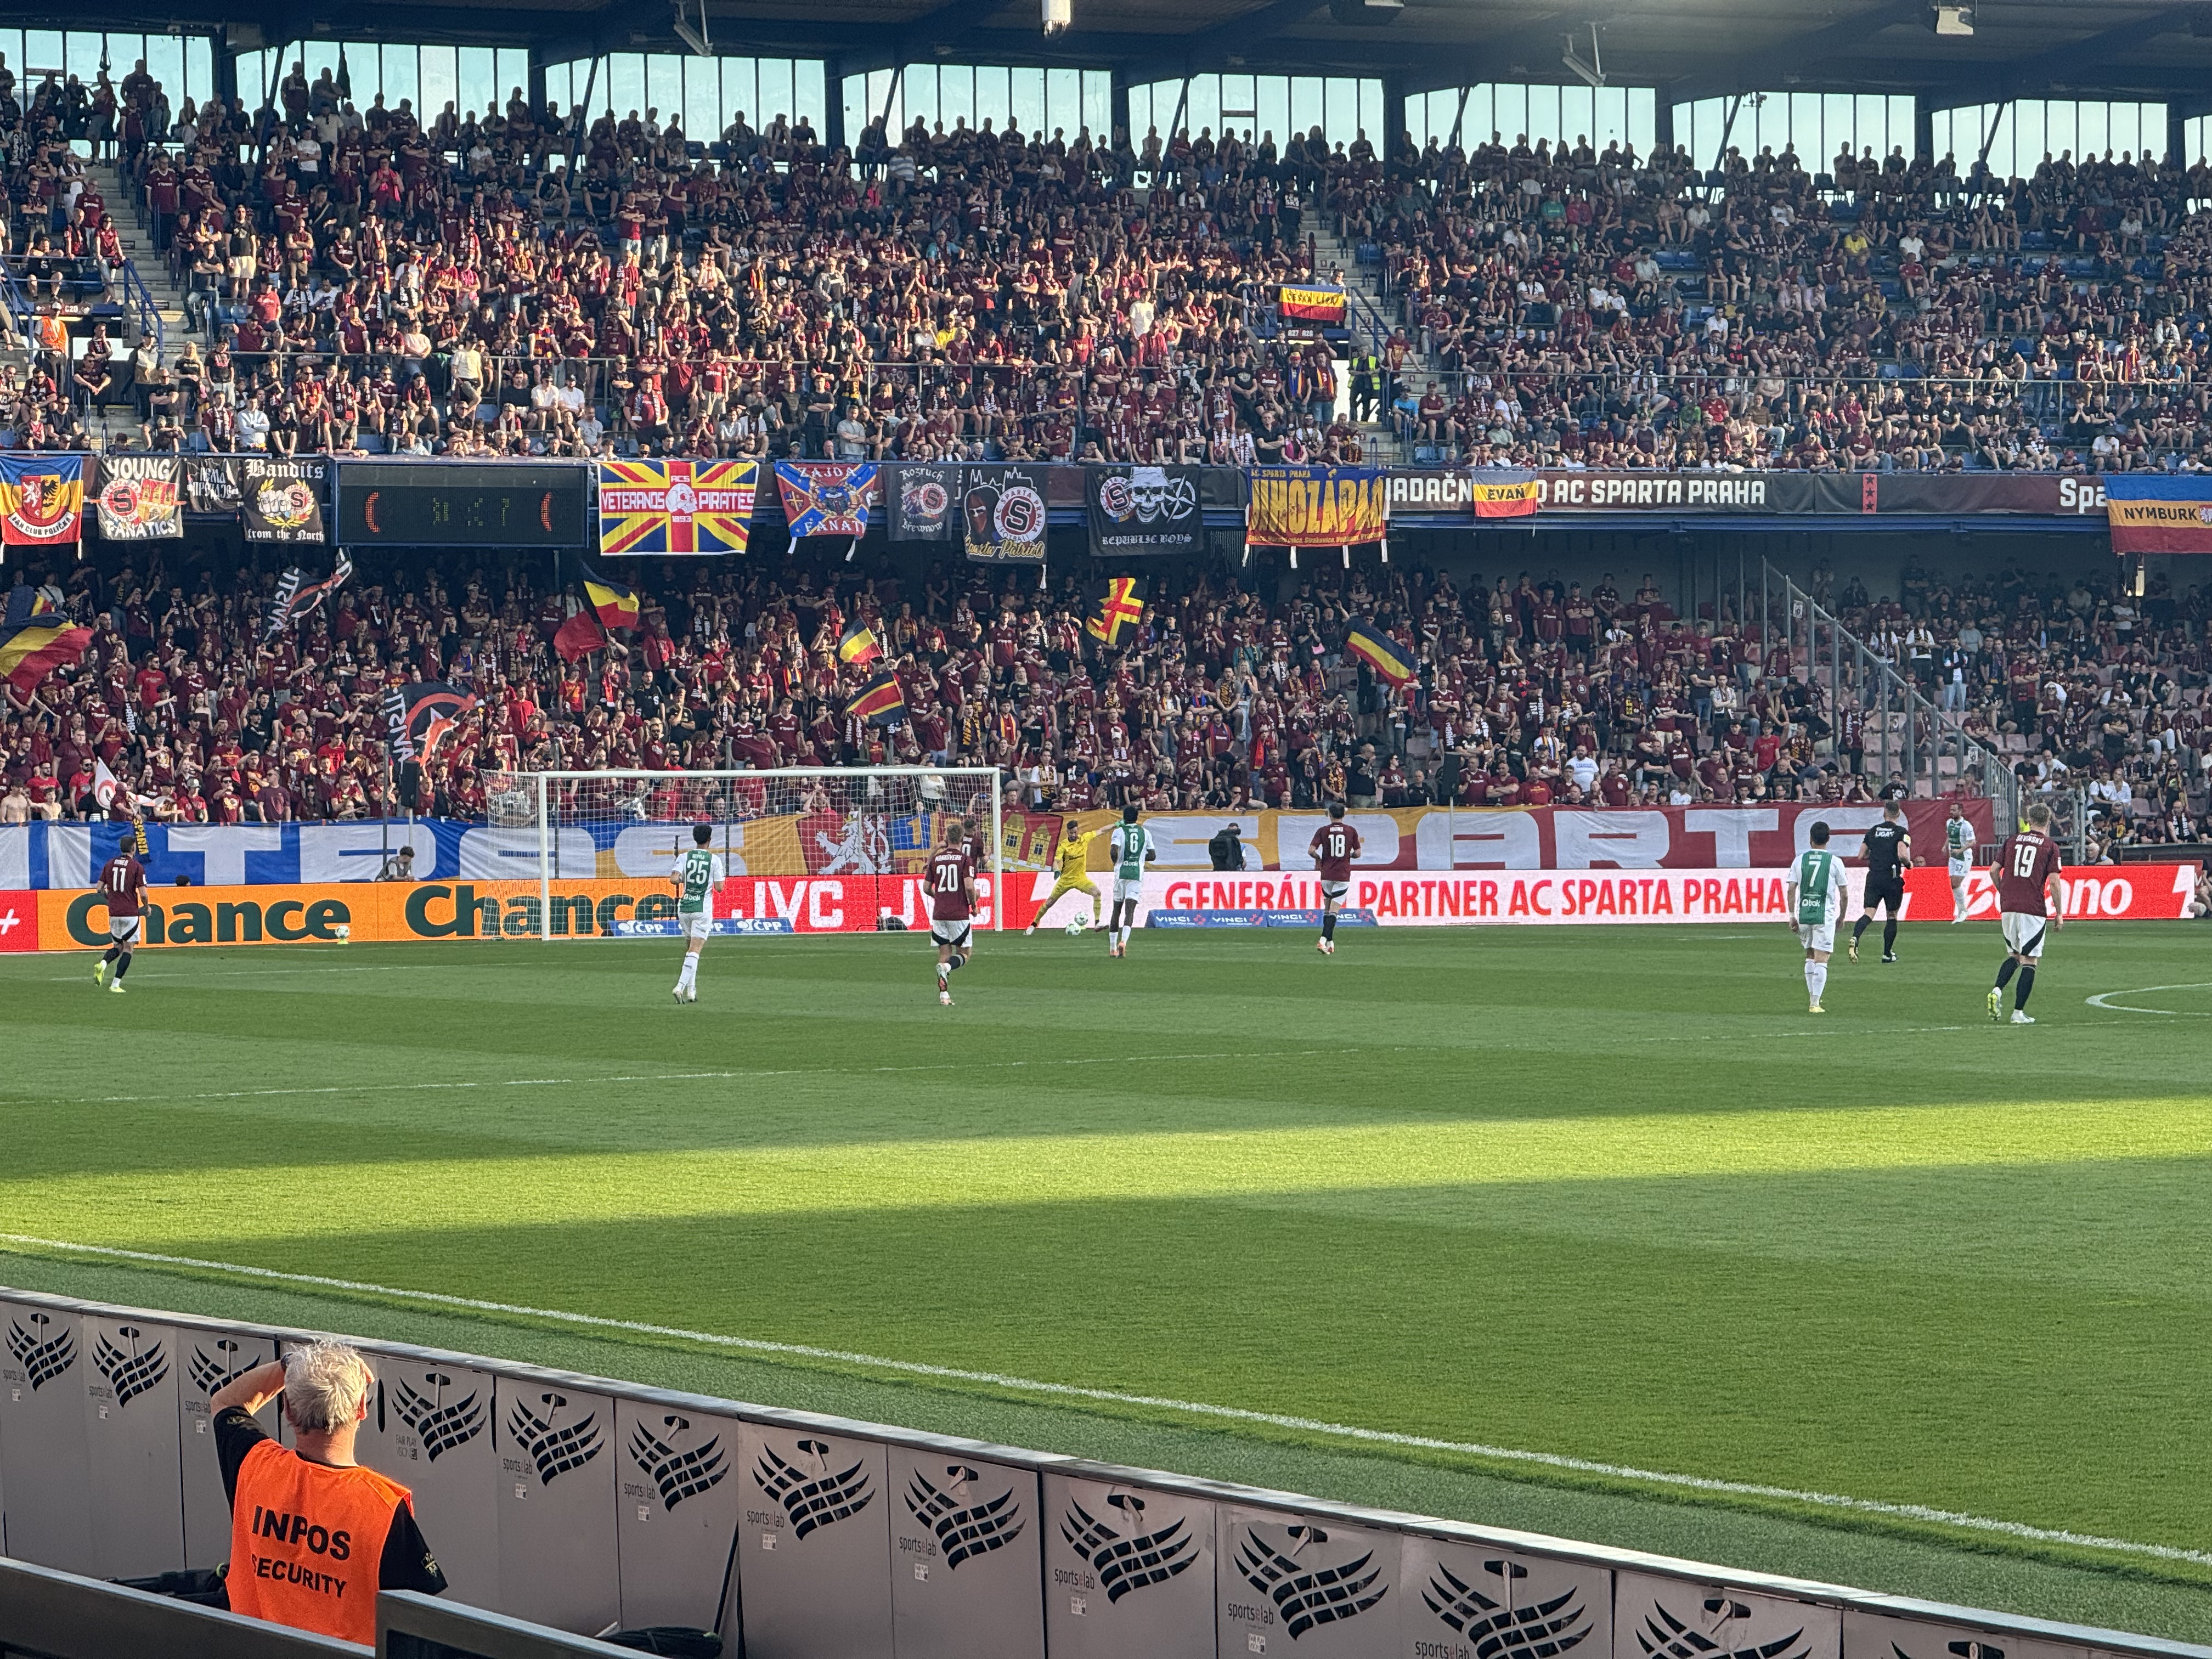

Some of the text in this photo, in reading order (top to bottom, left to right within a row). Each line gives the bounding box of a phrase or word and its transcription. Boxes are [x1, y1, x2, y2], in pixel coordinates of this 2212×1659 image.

[107, 457, 170, 480] YOUNG
[245, 459, 325, 479] Bandits
[798, 467, 857, 477] ZAJDA
[900, 468, 945, 482] Rozruch
[601, 492, 755, 510] VETERANOS PIRATES
[1487, 484, 1526, 500] EVAŇ
[1554, 479, 1584, 503] AC
[1591, 479, 1681, 503] SPARTA
[1688, 479, 1765, 504] PRAHA
[2123, 506, 2198, 521] NYMBURK
[12, 516, 72, 535] FAN CLUB POLIČKA
[104, 518, 177, 538] FANATICS
[247, 528, 324, 543] from the North
[1102, 533, 1193, 546] REPUBLIC BOYS
[1130, 832, 1139, 853] 6
[1328, 834, 1346, 857] 18
[1955, 864, 1963, 873] 57
[2013, 844, 2037, 878] 19
[112, 867, 127, 892] 11
[686, 859, 709, 884] 25
[936, 864, 959, 893] 20
[1808, 861, 1821, 887] 7
[1359, 881, 1498, 917] PARTNER
[1508, 879, 1553, 916] AC
[1562, 879, 1673, 915] SPARTA
[1684, 878, 1786, 915] PRAHA
[635, 920, 664, 933] ČPP
[753, 919, 782, 932] ČPP
[251, 1504, 352, 1561] INPOS
[251, 1553, 348, 1599] SECURITY
